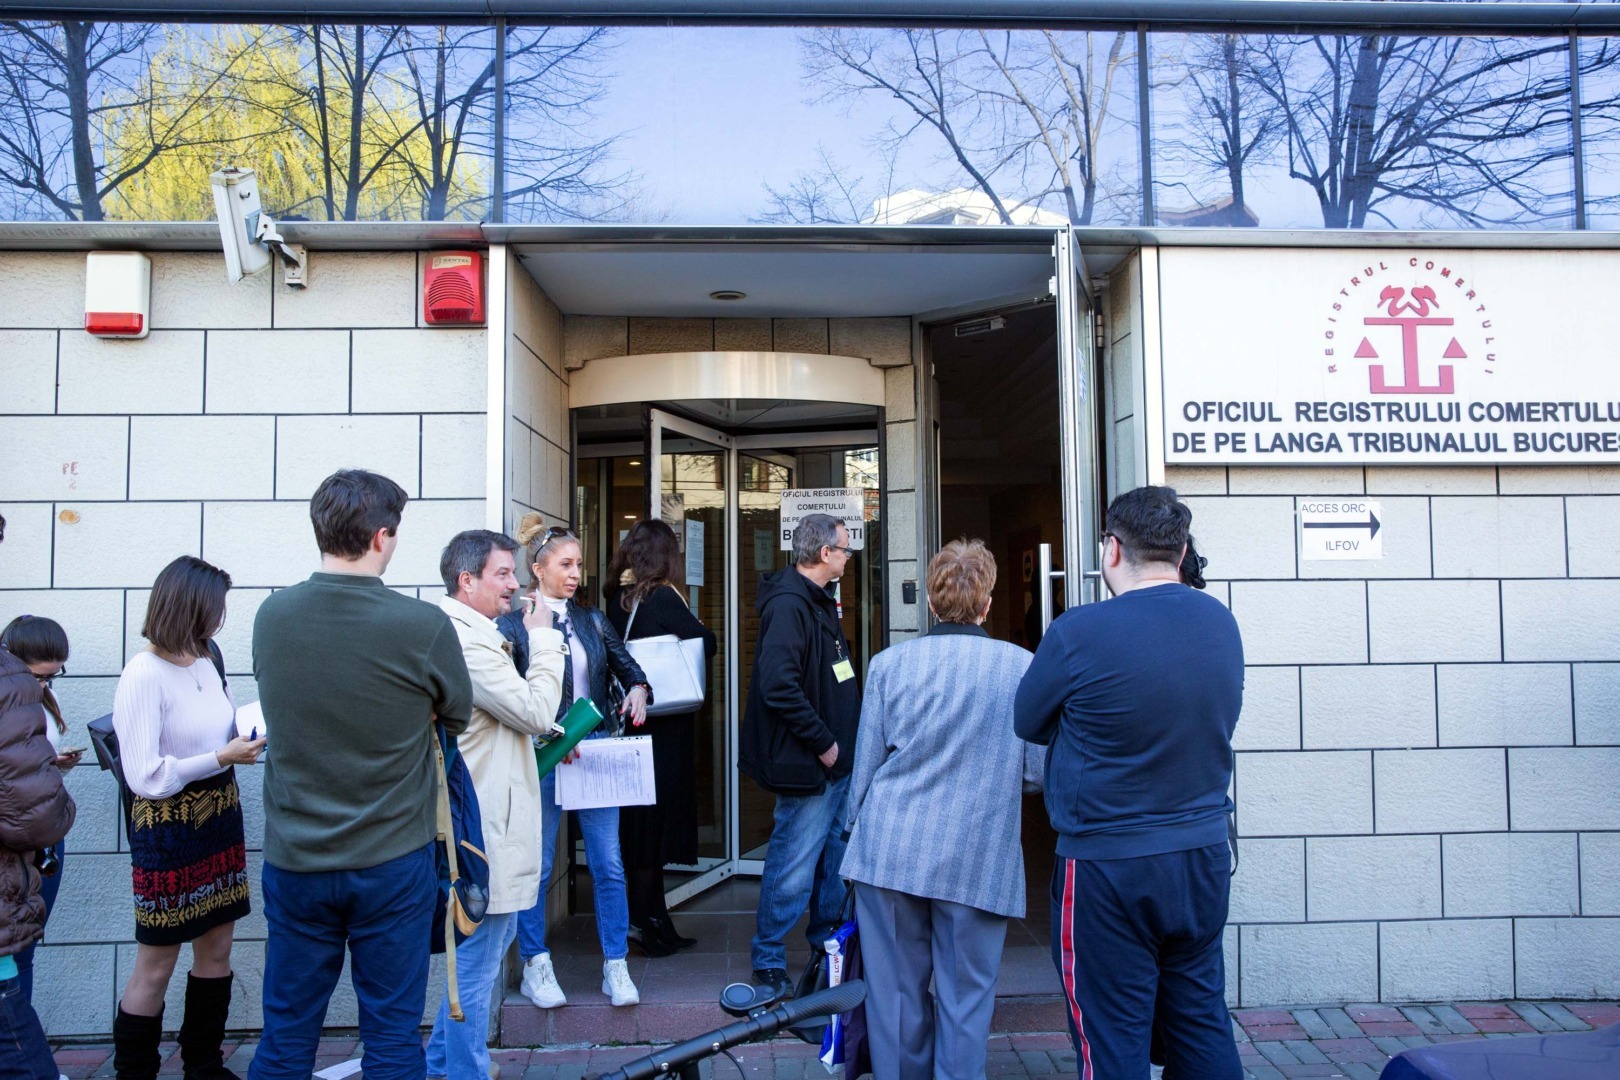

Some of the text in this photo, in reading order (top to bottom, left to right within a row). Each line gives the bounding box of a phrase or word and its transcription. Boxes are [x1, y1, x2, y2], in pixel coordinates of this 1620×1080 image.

[1325, 257, 1496, 374] REGISTRUL COMERTULUI
[1183, 401, 1282, 422] OFICIUL
[1295, 401, 1460, 422] REGISTRULUI
[1173, 432, 1620, 453] DE PE LANGA TRIBUNALUL BUCURE
[1302, 503, 1366, 513] ACCES ORC
[1325, 540, 1360, 551] ILFOV
